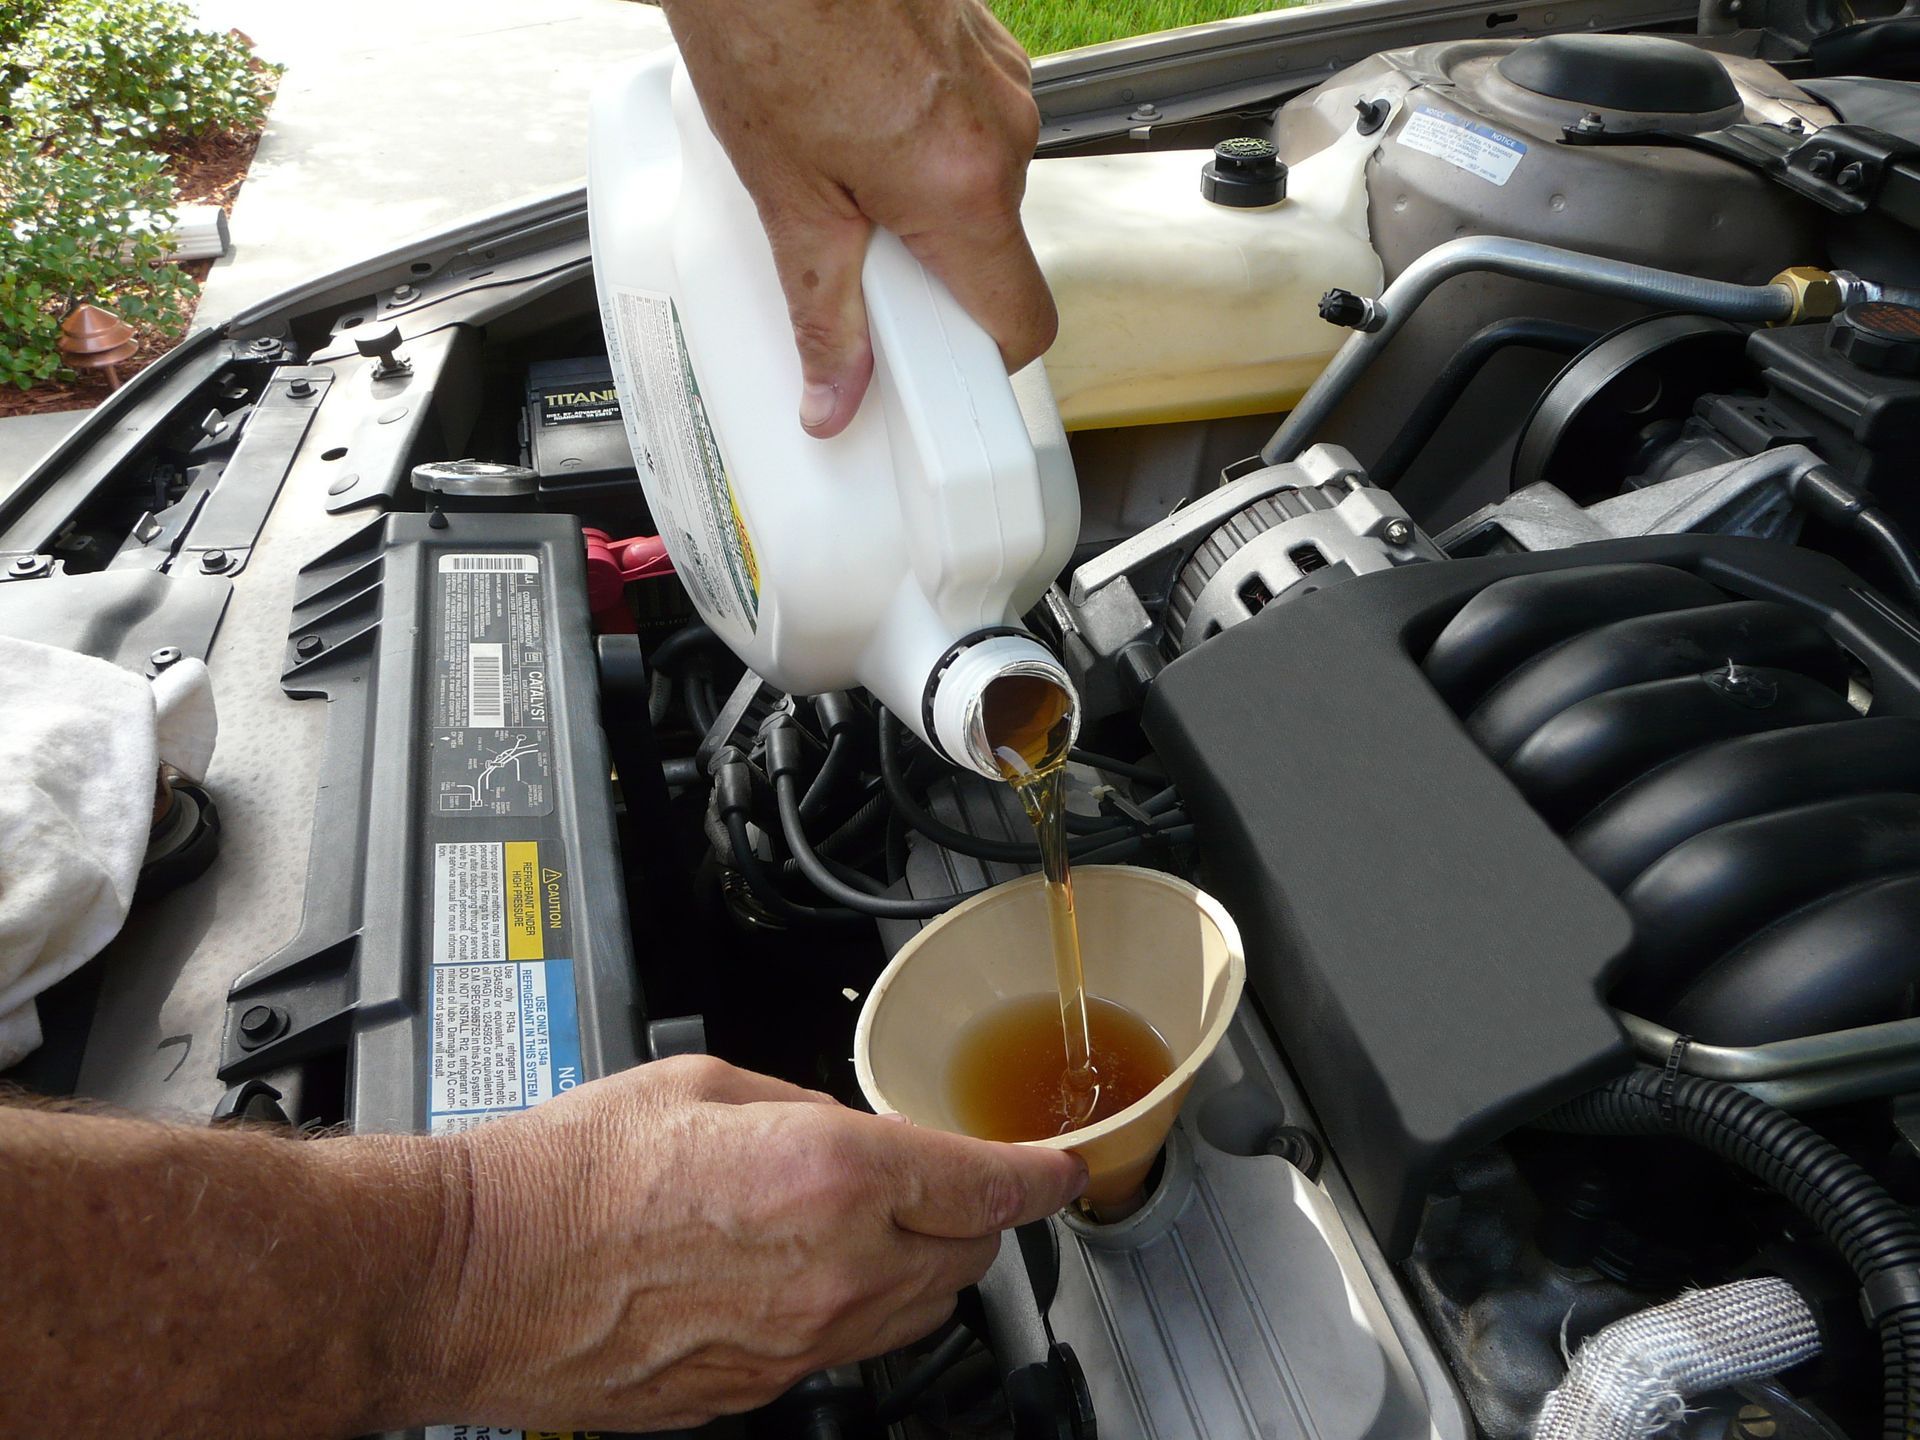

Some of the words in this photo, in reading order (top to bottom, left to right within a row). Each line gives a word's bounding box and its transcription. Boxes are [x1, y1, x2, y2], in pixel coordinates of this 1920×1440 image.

[1426, 107, 1445, 118] NOTICE
[1491, 132, 1516, 148] NOTICE
[524, 614, 534, 646] INFORMATION
[529, 672, 544, 722] CATALYST
[469, 845, 477, 856] only
[479, 845, 488, 869] personal
[490, 845, 498, 871] Improper
[458, 872, 467, 897] qualified
[469, 873, 478, 908] discharging
[478, 871, 488, 888] injury.
[513, 871, 521, 887] HIGH
[523, 862, 534, 909] REFRIGERANT
[479, 890, 489, 912] Fittings
[514, 890, 523, 927] PRESSURE
[548, 884, 561, 928] CAUTION
[469, 910, 478, 934] through
[491, 924, 500, 937] may
[526, 911, 535, 935] UNDER
[448, 934, 456, 960] informa-
[460, 935, 468, 960] Consult
[435, 969, 444, 995] pressor
[448, 969, 457, 993] mineral
[460, 968, 468, 979] DO
[494, 967, 503, 998] 12345922
[505, 966, 513, 979] Use
[460, 983, 469, 998] NOT
[471, 985, 480, 1004] SPEC
[481, 977, 491, 996] (PAG)
[504, 988, 514, 1002] only
[523, 970, 534, 1025] REFRIGERANT
[436, 998, 445, 1010] and
[448, 1007, 457, 1024] lube.
[536, 996, 545, 1012] USE
[434, 1014, 444, 1039] system
[460, 1003, 469, 1033] INSTALL
[471, 1006, 480, 1036] 9985752
[483, 1012, 492, 1045] 12345923
[506, 1012, 515, 1033] R134a
[536, 1015, 547, 1036] ONLY
[493, 1011, 505, 1049] equivalent,
[525, 1028, 534, 1036] IN
[436, 1042, 444, 1053] will
[446, 1027, 457, 1058] Damage
[460, 1038, 469, 1051] R12
[472, 1046, 481, 1059] this
[526, 1039, 536, 1058] THIS
[435, 1056, 444, 1079] result.
[471, 1061, 481, 1074] A/C
[496, 1053, 505, 1066] and
[506, 1043, 516, 1081] refrigerant
[538, 1047, 547, 1065] 134a
[447, 1071, 457, 1085] A/C
[458, 1056, 469, 1094] refrigerant
[482, 1057, 493, 1096] equivalent
[526, 1062, 537, 1096] SYSTEM
[470, 1076, 481, 1106] system.
[494, 1070, 506, 1104] synthetic
[460, 1099, 467, 1107] or
